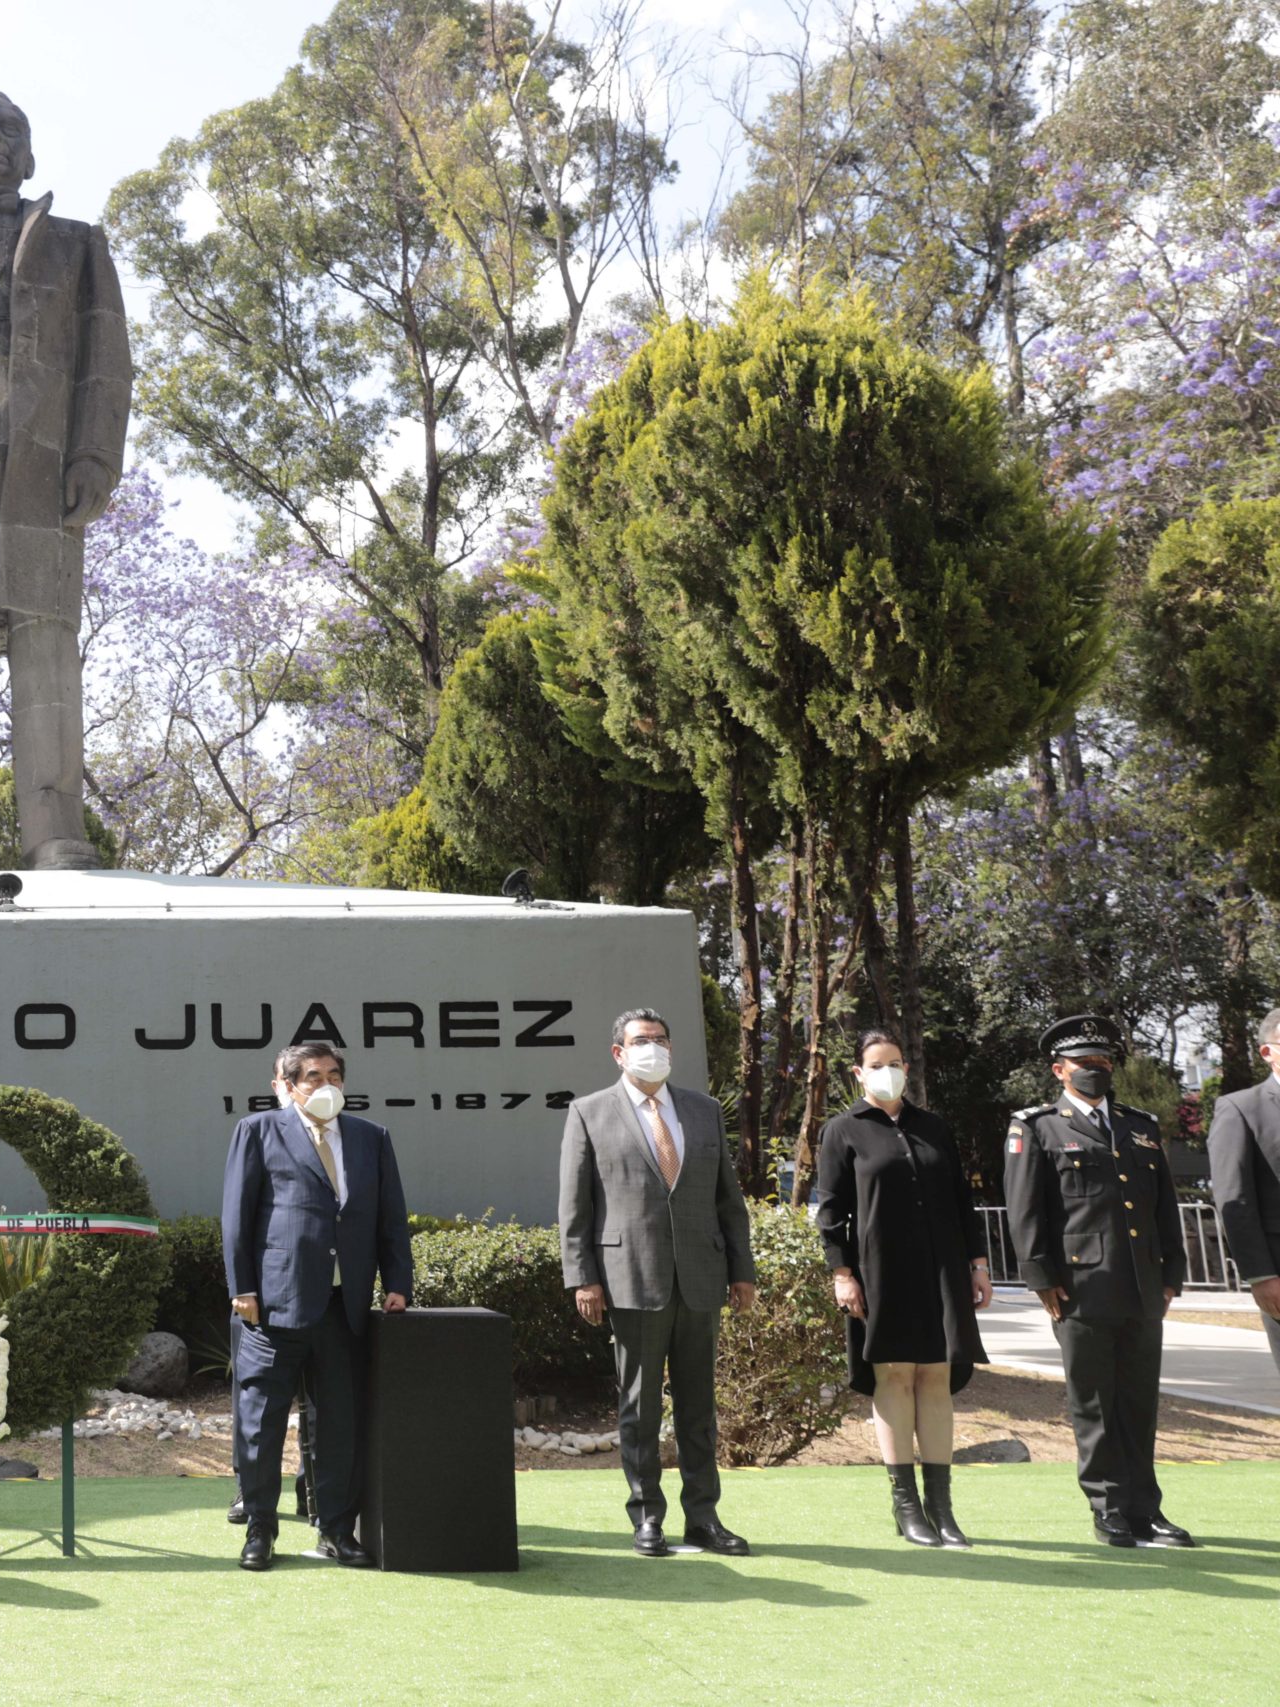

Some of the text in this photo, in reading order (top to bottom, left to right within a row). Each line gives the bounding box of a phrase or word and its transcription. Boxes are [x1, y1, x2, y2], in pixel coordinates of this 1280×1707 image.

[134, 999, 576, 1050] JUAREZ
[223, 1089, 577, 1115] 186-1872
[6, 1217, 24, 1231] DE
[35, 1216, 91, 1232] PUEBLA
